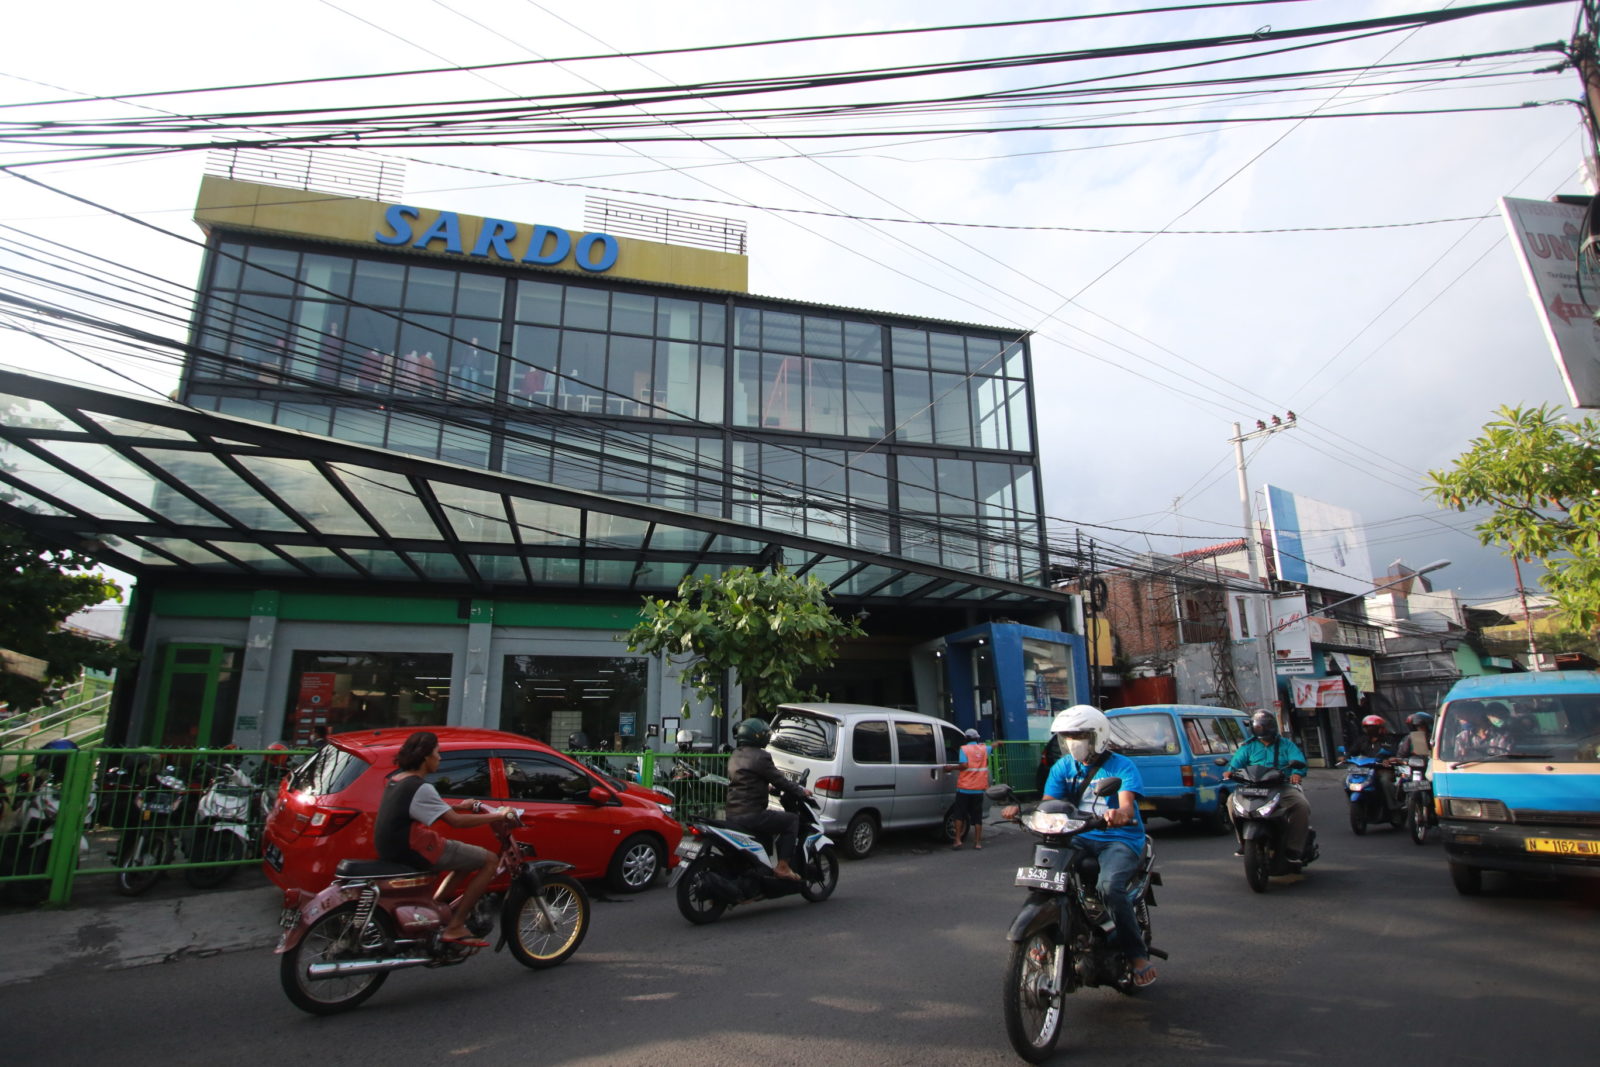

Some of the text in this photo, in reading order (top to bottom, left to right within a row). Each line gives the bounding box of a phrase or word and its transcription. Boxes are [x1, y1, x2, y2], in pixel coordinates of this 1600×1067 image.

[375, 204, 619, 273] SARDO
[1529, 839, 1537, 851] N
[1552, 840, 1577, 854] 1162
[1028, 868, 1048, 879] 5436
[1054, 872, 1066, 883] AE
